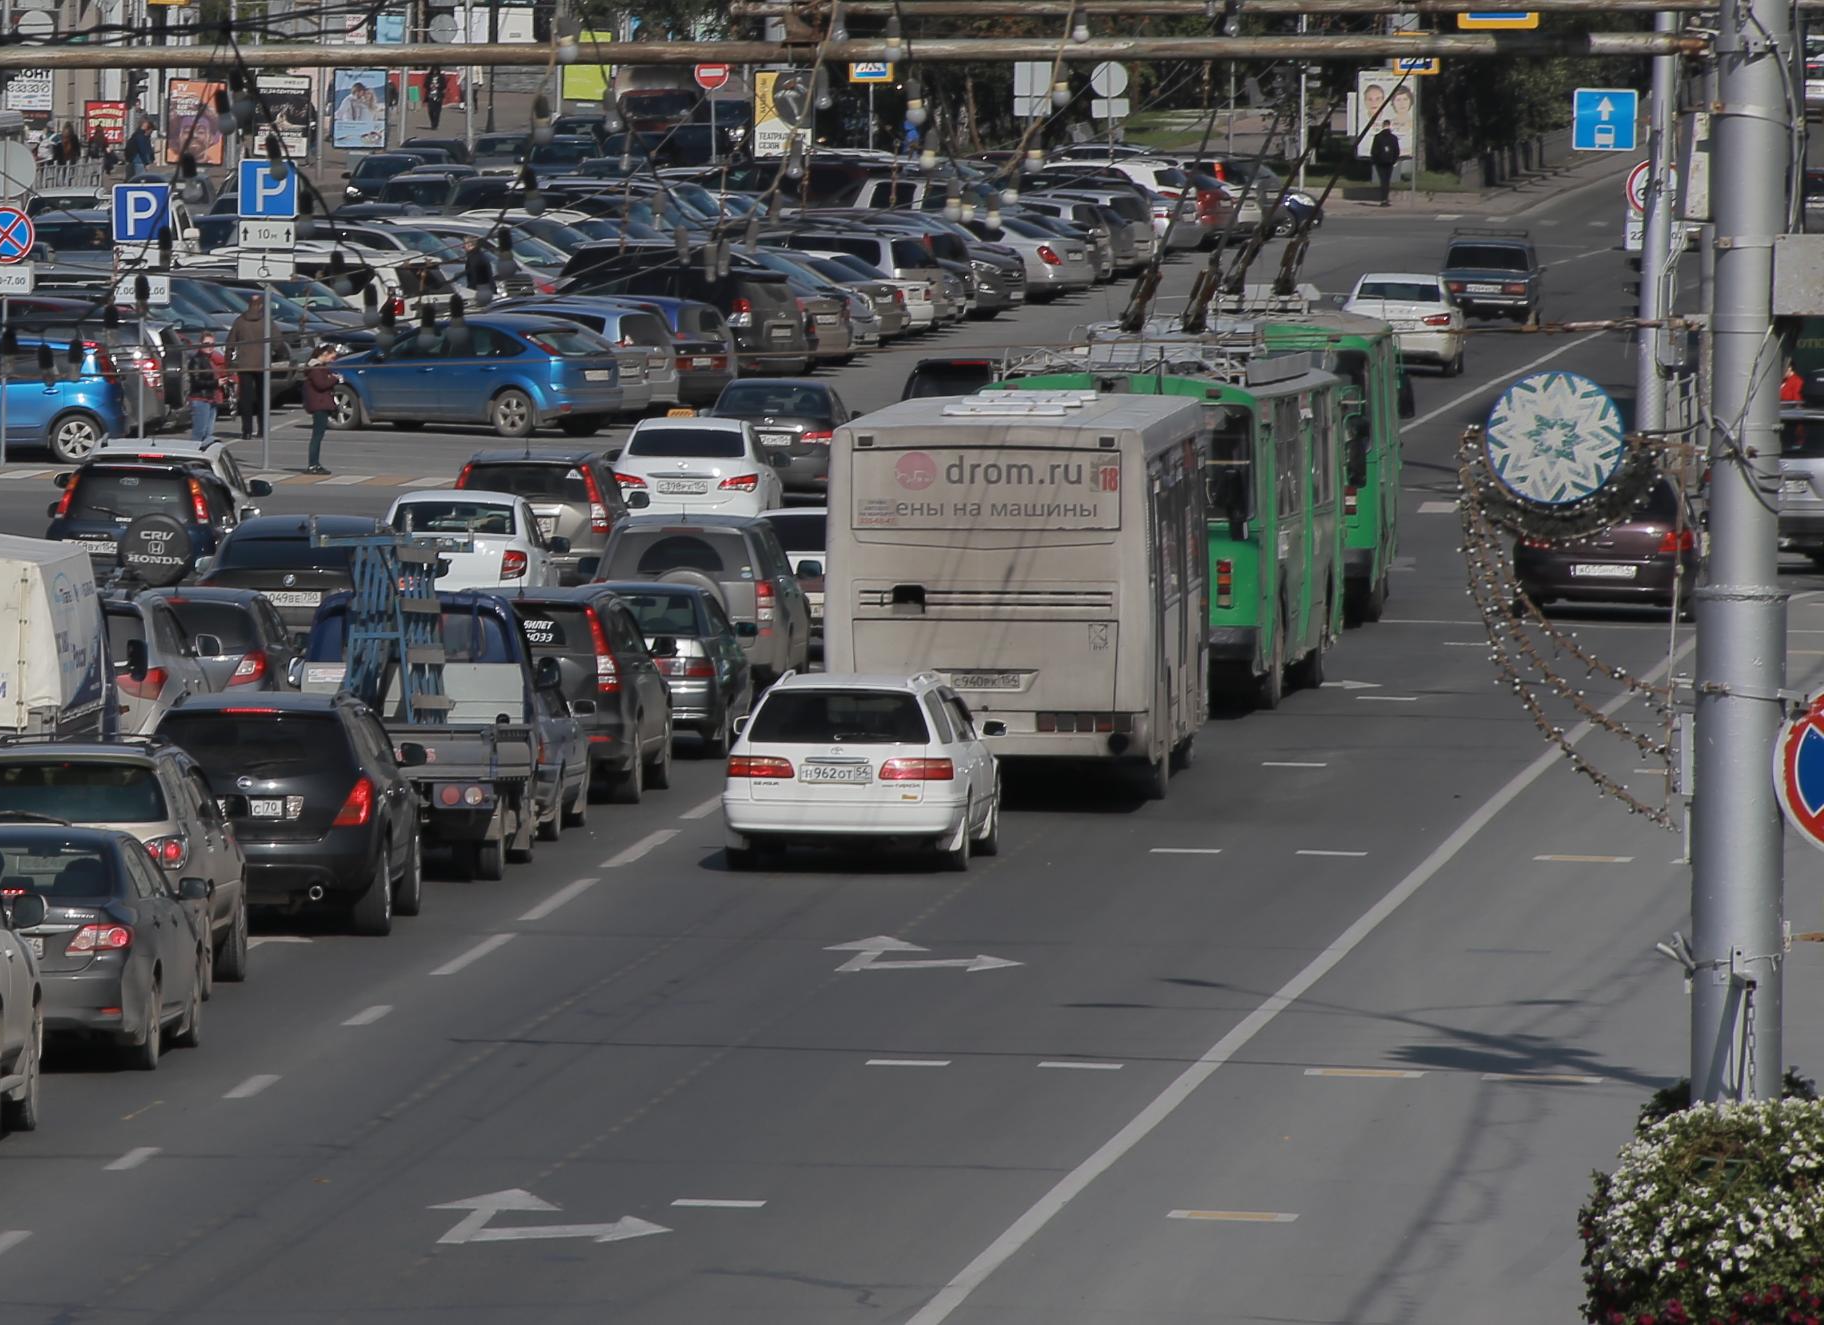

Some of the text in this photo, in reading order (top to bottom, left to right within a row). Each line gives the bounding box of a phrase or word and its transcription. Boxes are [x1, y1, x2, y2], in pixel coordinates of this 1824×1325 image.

[945, 455, 1083, 486] drom.ru
[1100, 467, 1119, 492] 18
[896, 502, 945, 517] ены
[953, 502, 982, 517] на
[991, 502, 1098, 518] машины
[127, 554, 185, 566] HONDA
